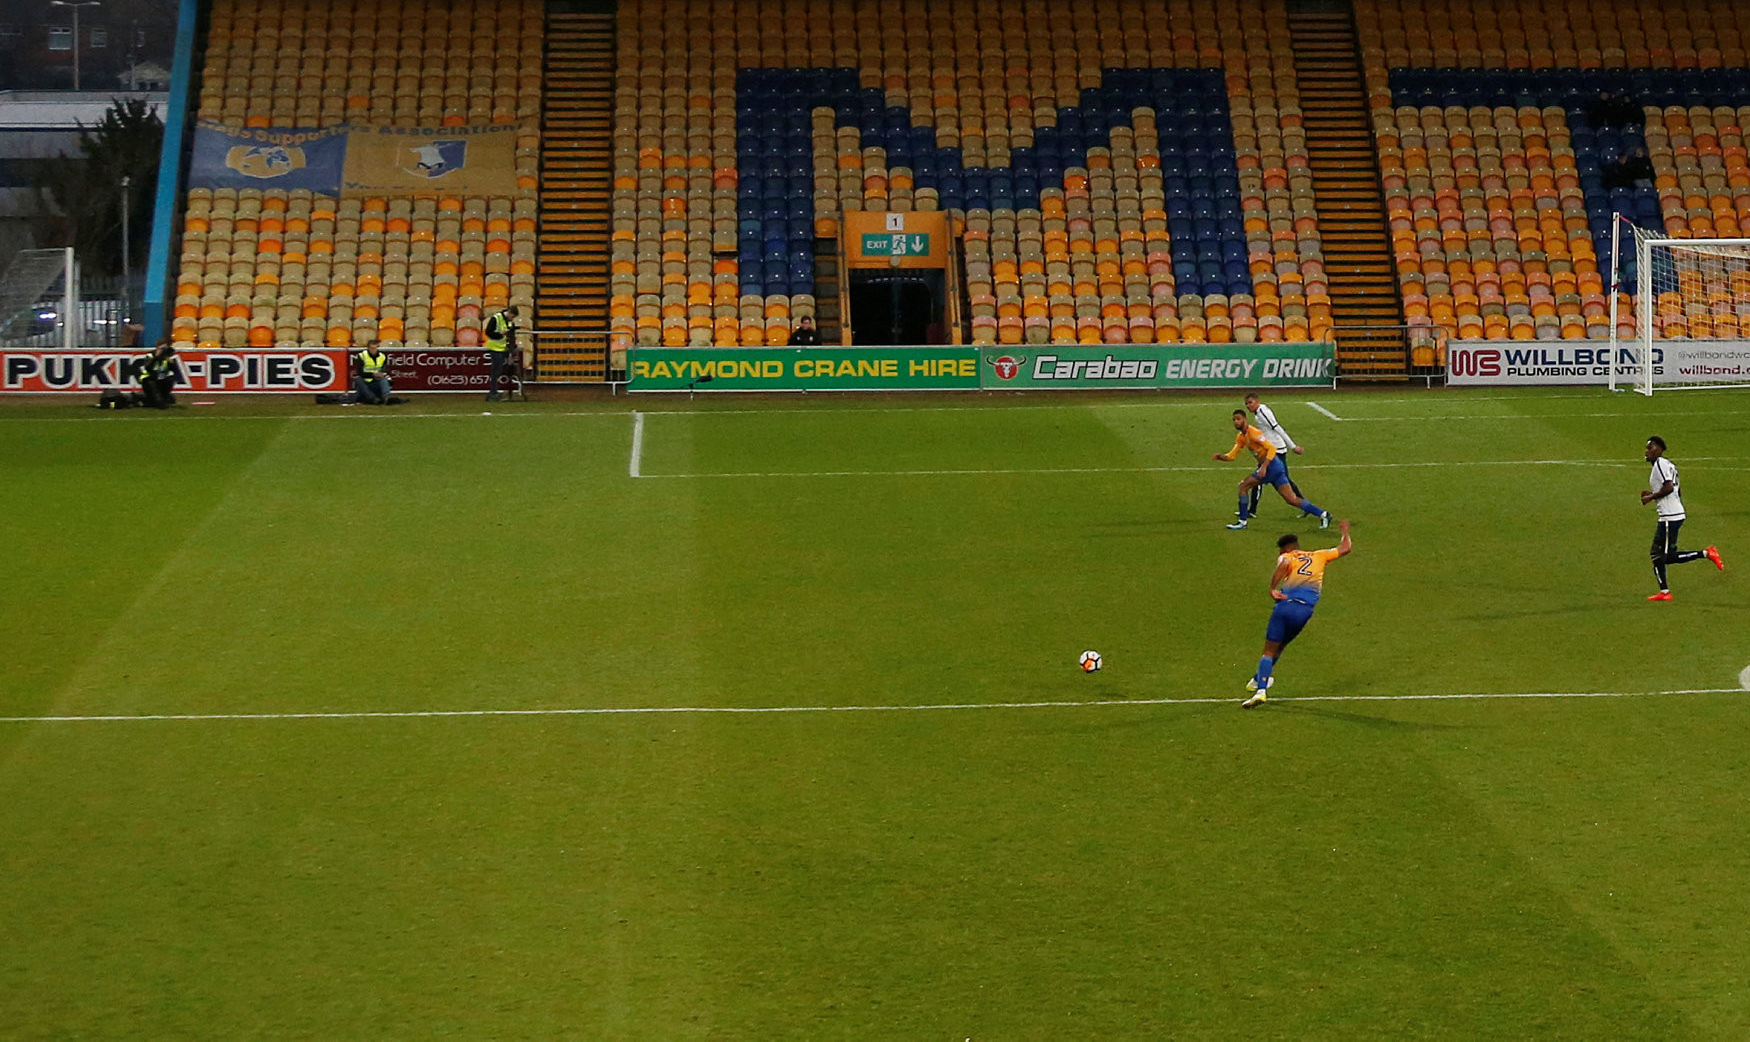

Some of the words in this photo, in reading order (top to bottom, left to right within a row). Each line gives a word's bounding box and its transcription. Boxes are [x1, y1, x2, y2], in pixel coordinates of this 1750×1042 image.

[866, 240, 888, 249] EXIT
[416, 353, 480, 368] Computer
[1031, 355, 1160, 380] Carabao
[1165, 358, 1260, 379] ENERGY
[633, 360, 784, 378] RAYMOND
[793, 359, 899, 378] CRANE
[908, 359, 976, 377] HIRE
[1507, 366, 1587, 377] PLUMBING
[427, 374, 468, 386] (01623)
[1297, 556, 1313, 576] 2
